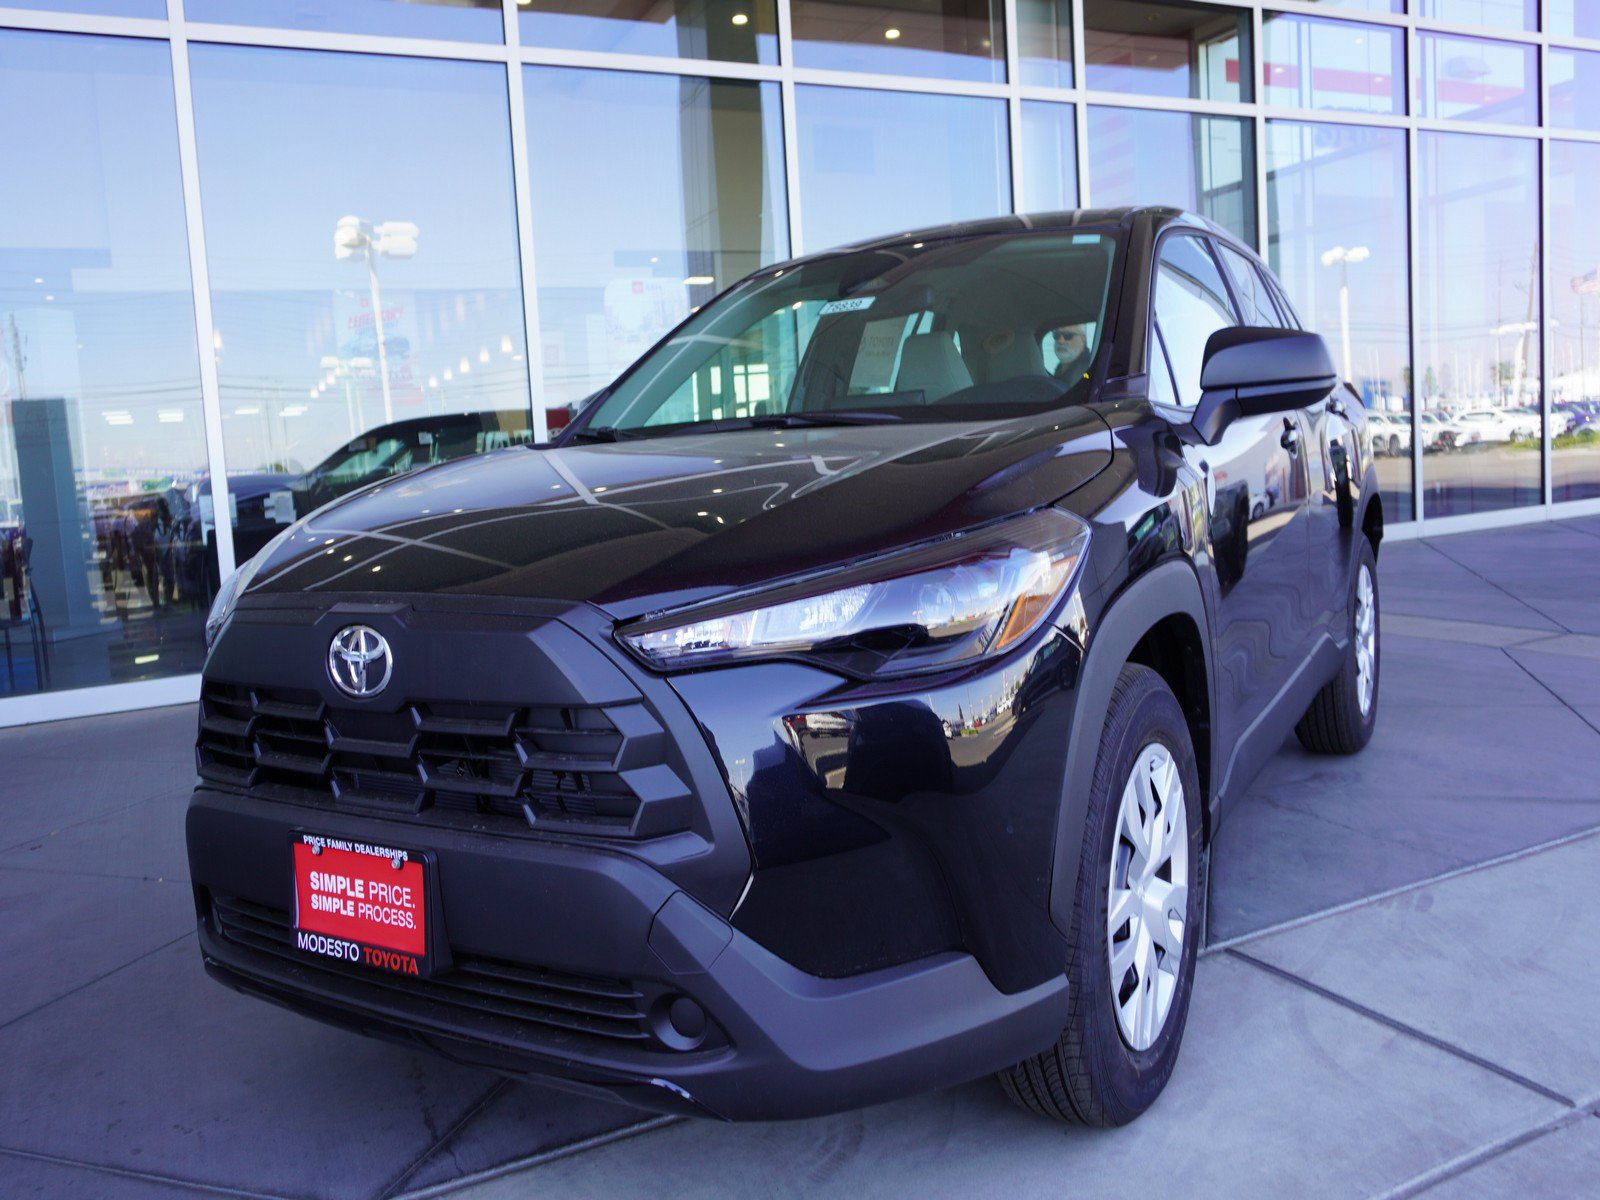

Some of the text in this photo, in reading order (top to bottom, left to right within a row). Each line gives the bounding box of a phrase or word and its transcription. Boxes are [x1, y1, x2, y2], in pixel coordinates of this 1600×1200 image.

[303, 835, 408, 862] PRICE FAMILY DEALERSHIPS
[310, 871, 416, 909] SIMPLE PRICE.
[311, 893, 417, 930] SIMPLE PROCESS.
[297, 931, 419, 976] MODESTO TOYOTA
